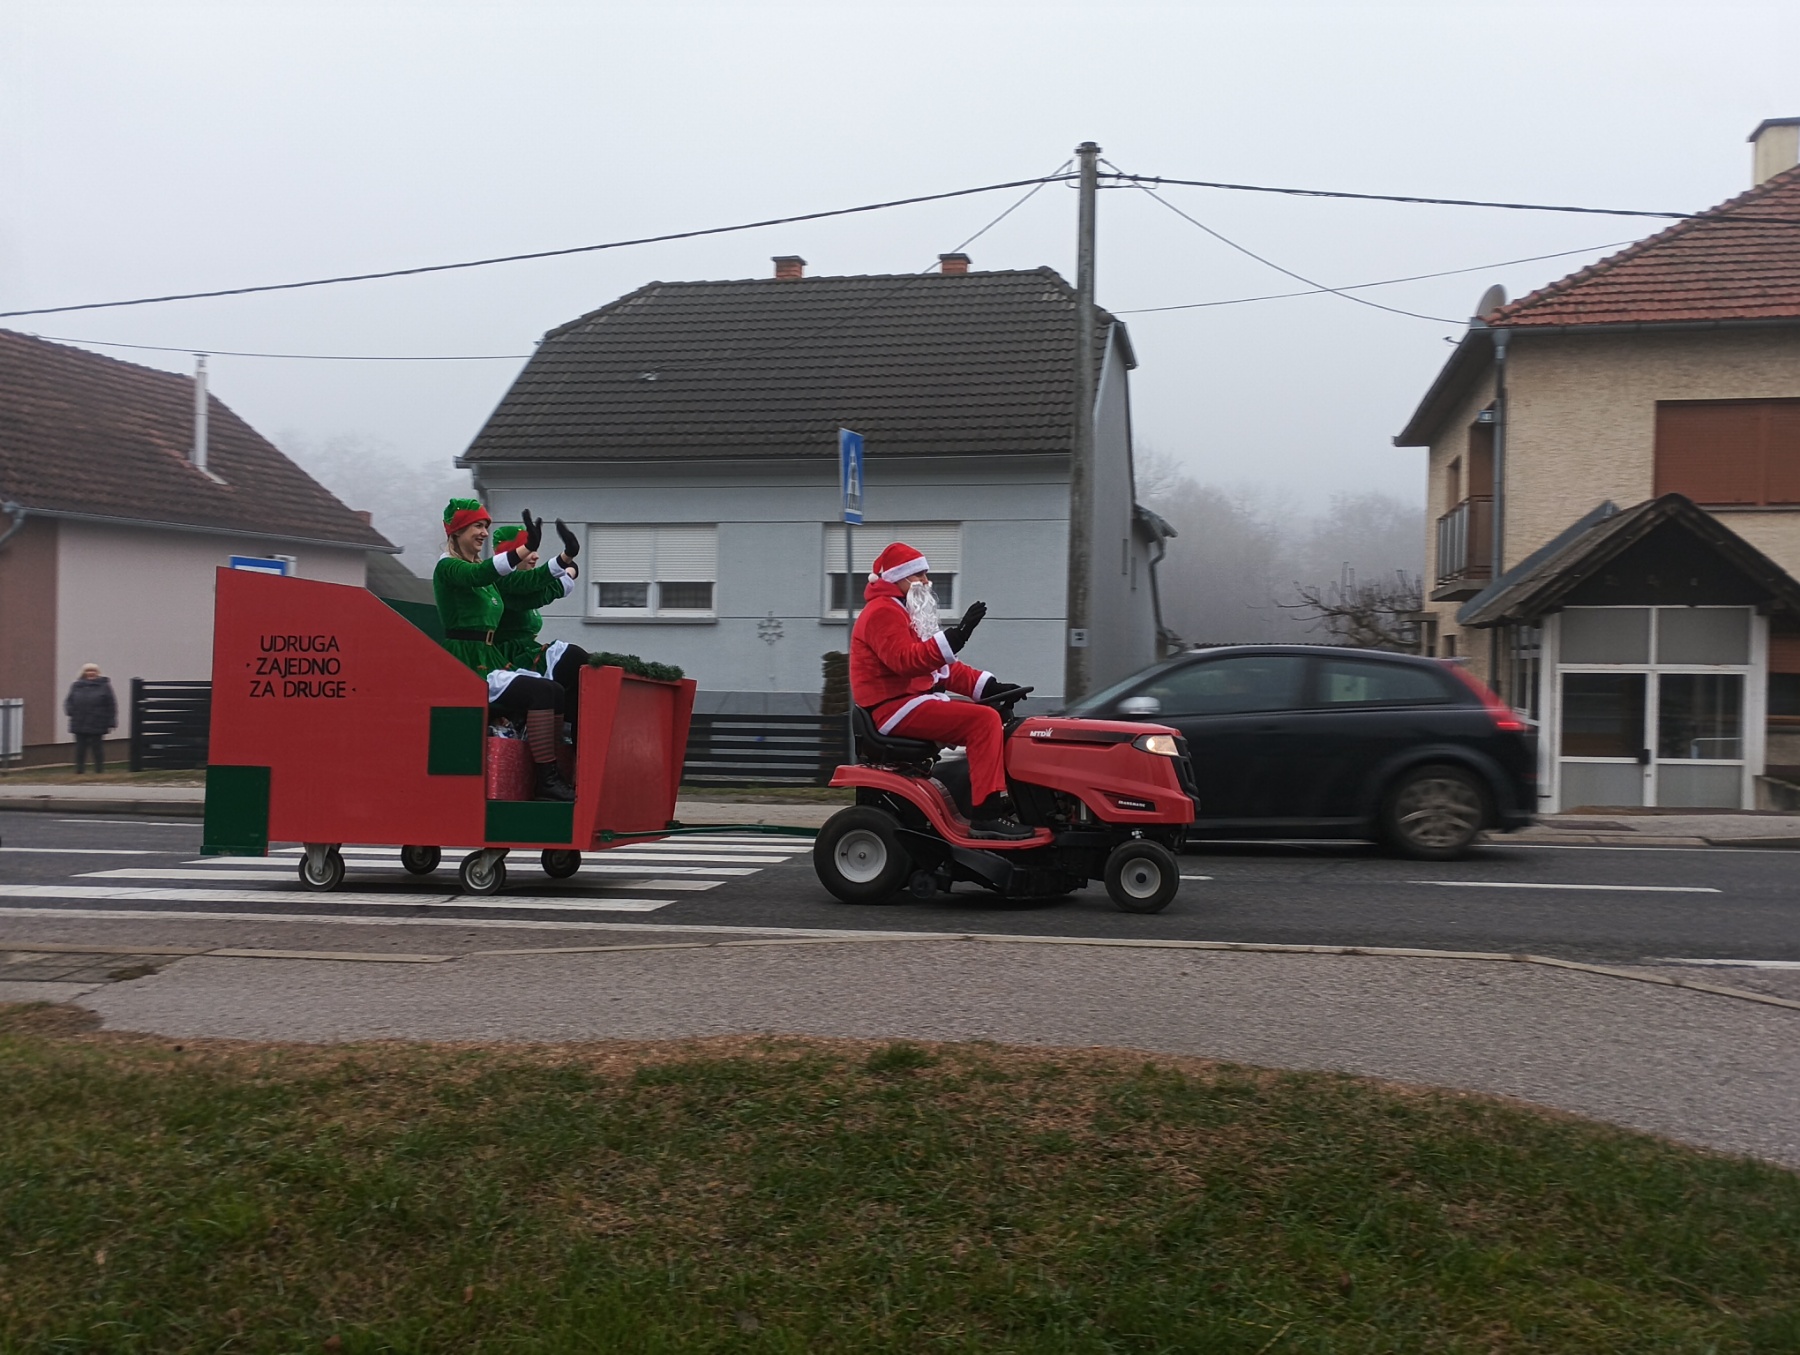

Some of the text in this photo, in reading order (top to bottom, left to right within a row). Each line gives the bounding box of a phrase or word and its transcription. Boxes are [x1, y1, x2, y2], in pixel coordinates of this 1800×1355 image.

[260, 635, 340, 652] UDRUGA
[256, 657, 341, 678] ZAJEDNO
[249, 681, 346, 698] ZA DRUGE
